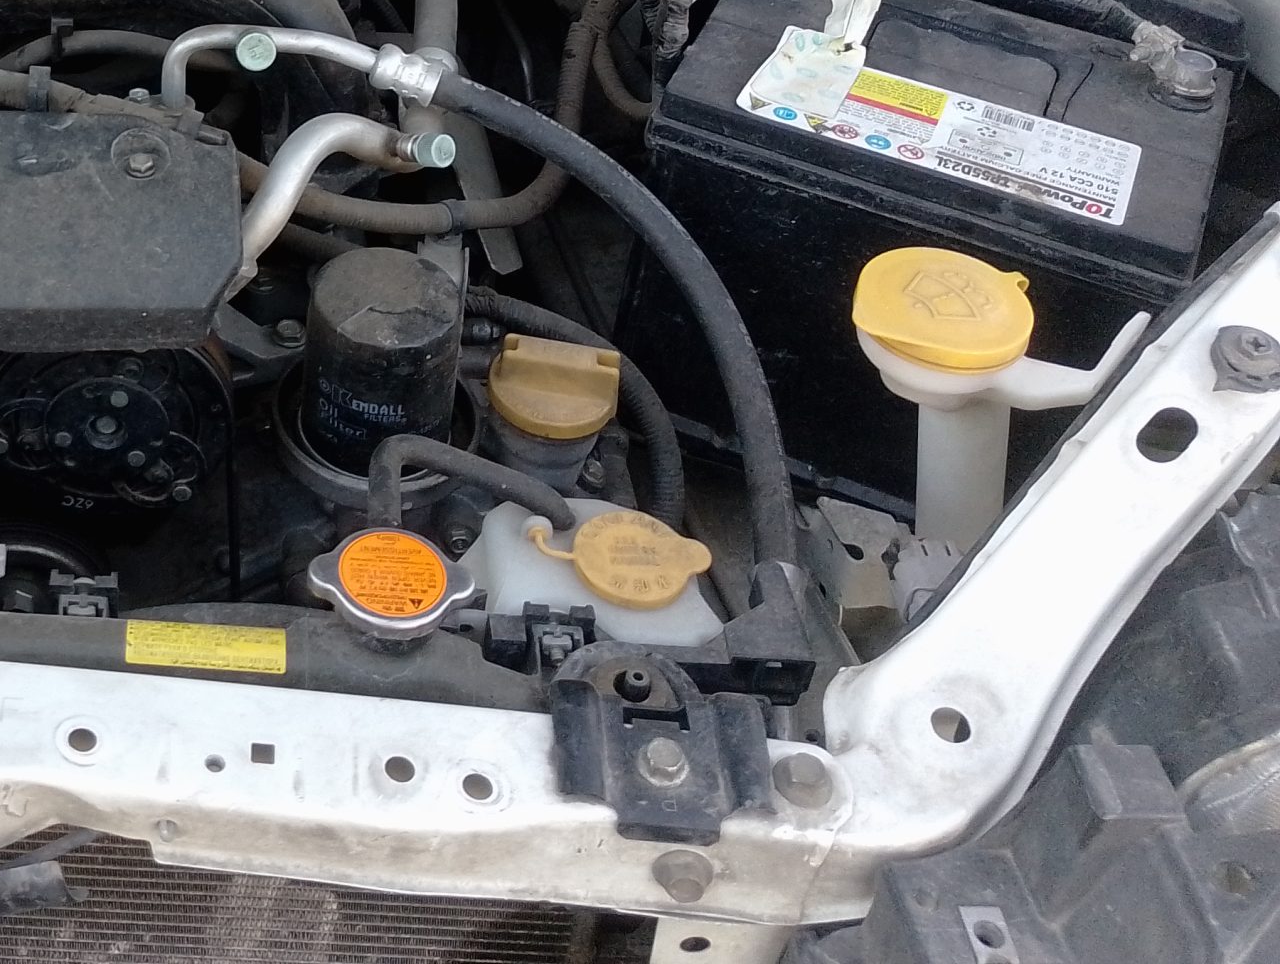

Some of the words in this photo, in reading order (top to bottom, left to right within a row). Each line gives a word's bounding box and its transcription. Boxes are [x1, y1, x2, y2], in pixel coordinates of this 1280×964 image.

[939, 145, 978, 161] BATTERY
[980, 157, 1021, 173] CALCIUM
[1039, 166, 1048, 174] V
[1023, 170, 1048, 181] FREE
[1051, 170, 1065, 179] 12
[1066, 166, 1120, 186] WARRANTY
[1069, 175, 1094, 188] CCA
[1051, 178, 1116, 202] MAINTENANCE
[1097, 183, 1119, 195] 510
